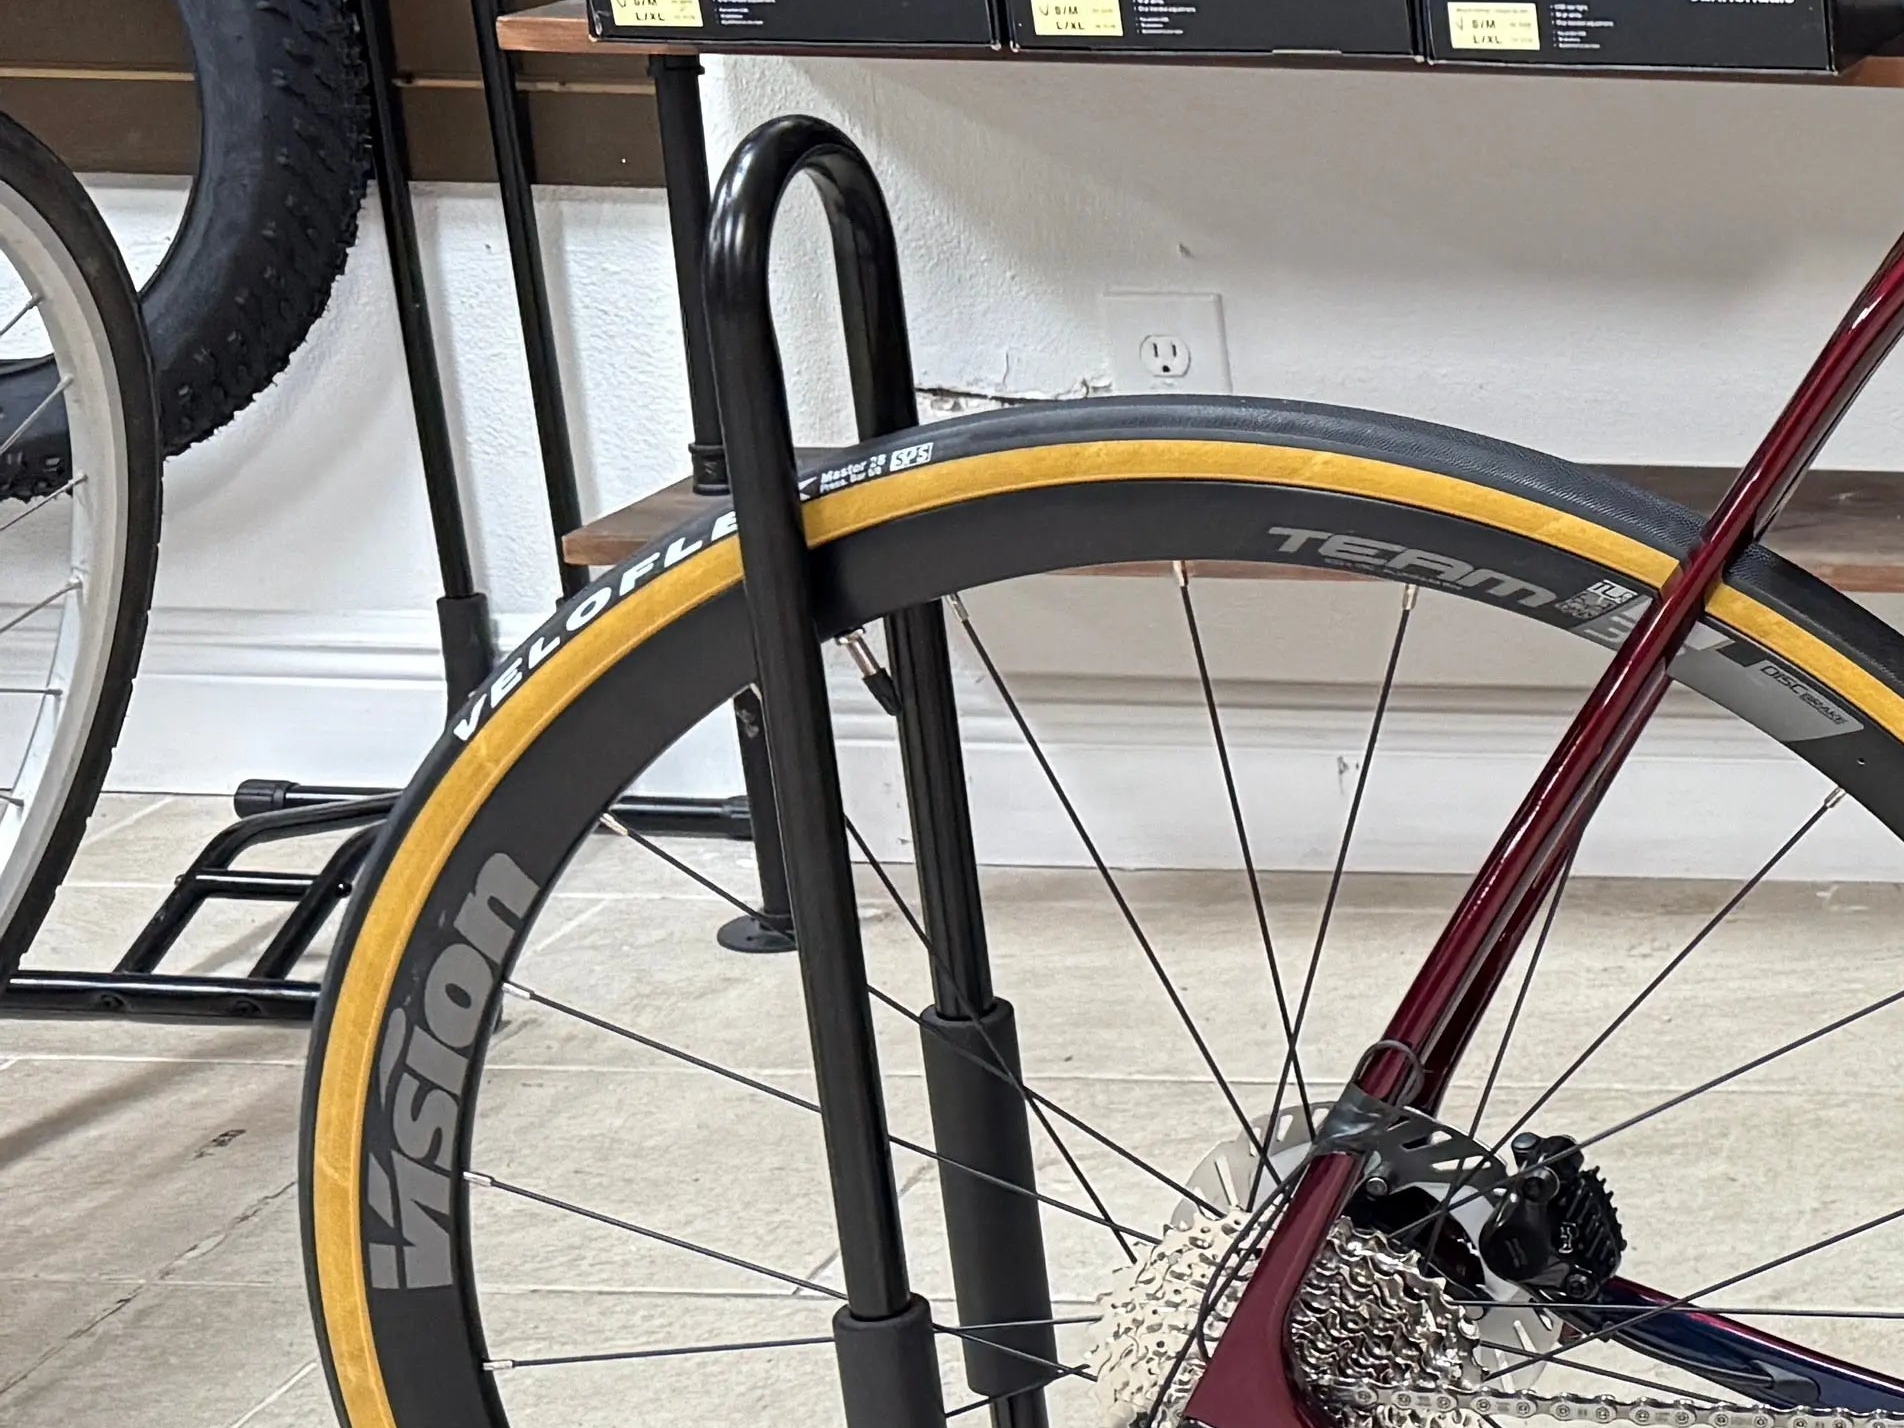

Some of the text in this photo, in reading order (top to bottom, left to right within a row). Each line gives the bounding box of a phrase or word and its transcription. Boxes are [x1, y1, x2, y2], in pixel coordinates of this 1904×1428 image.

[819, 460, 870, 484] Master
[1268, 524, 1560, 610] TEAM
[1759, 663, 1801, 693] DISC
[368, 849, 541, 1291] Vision
